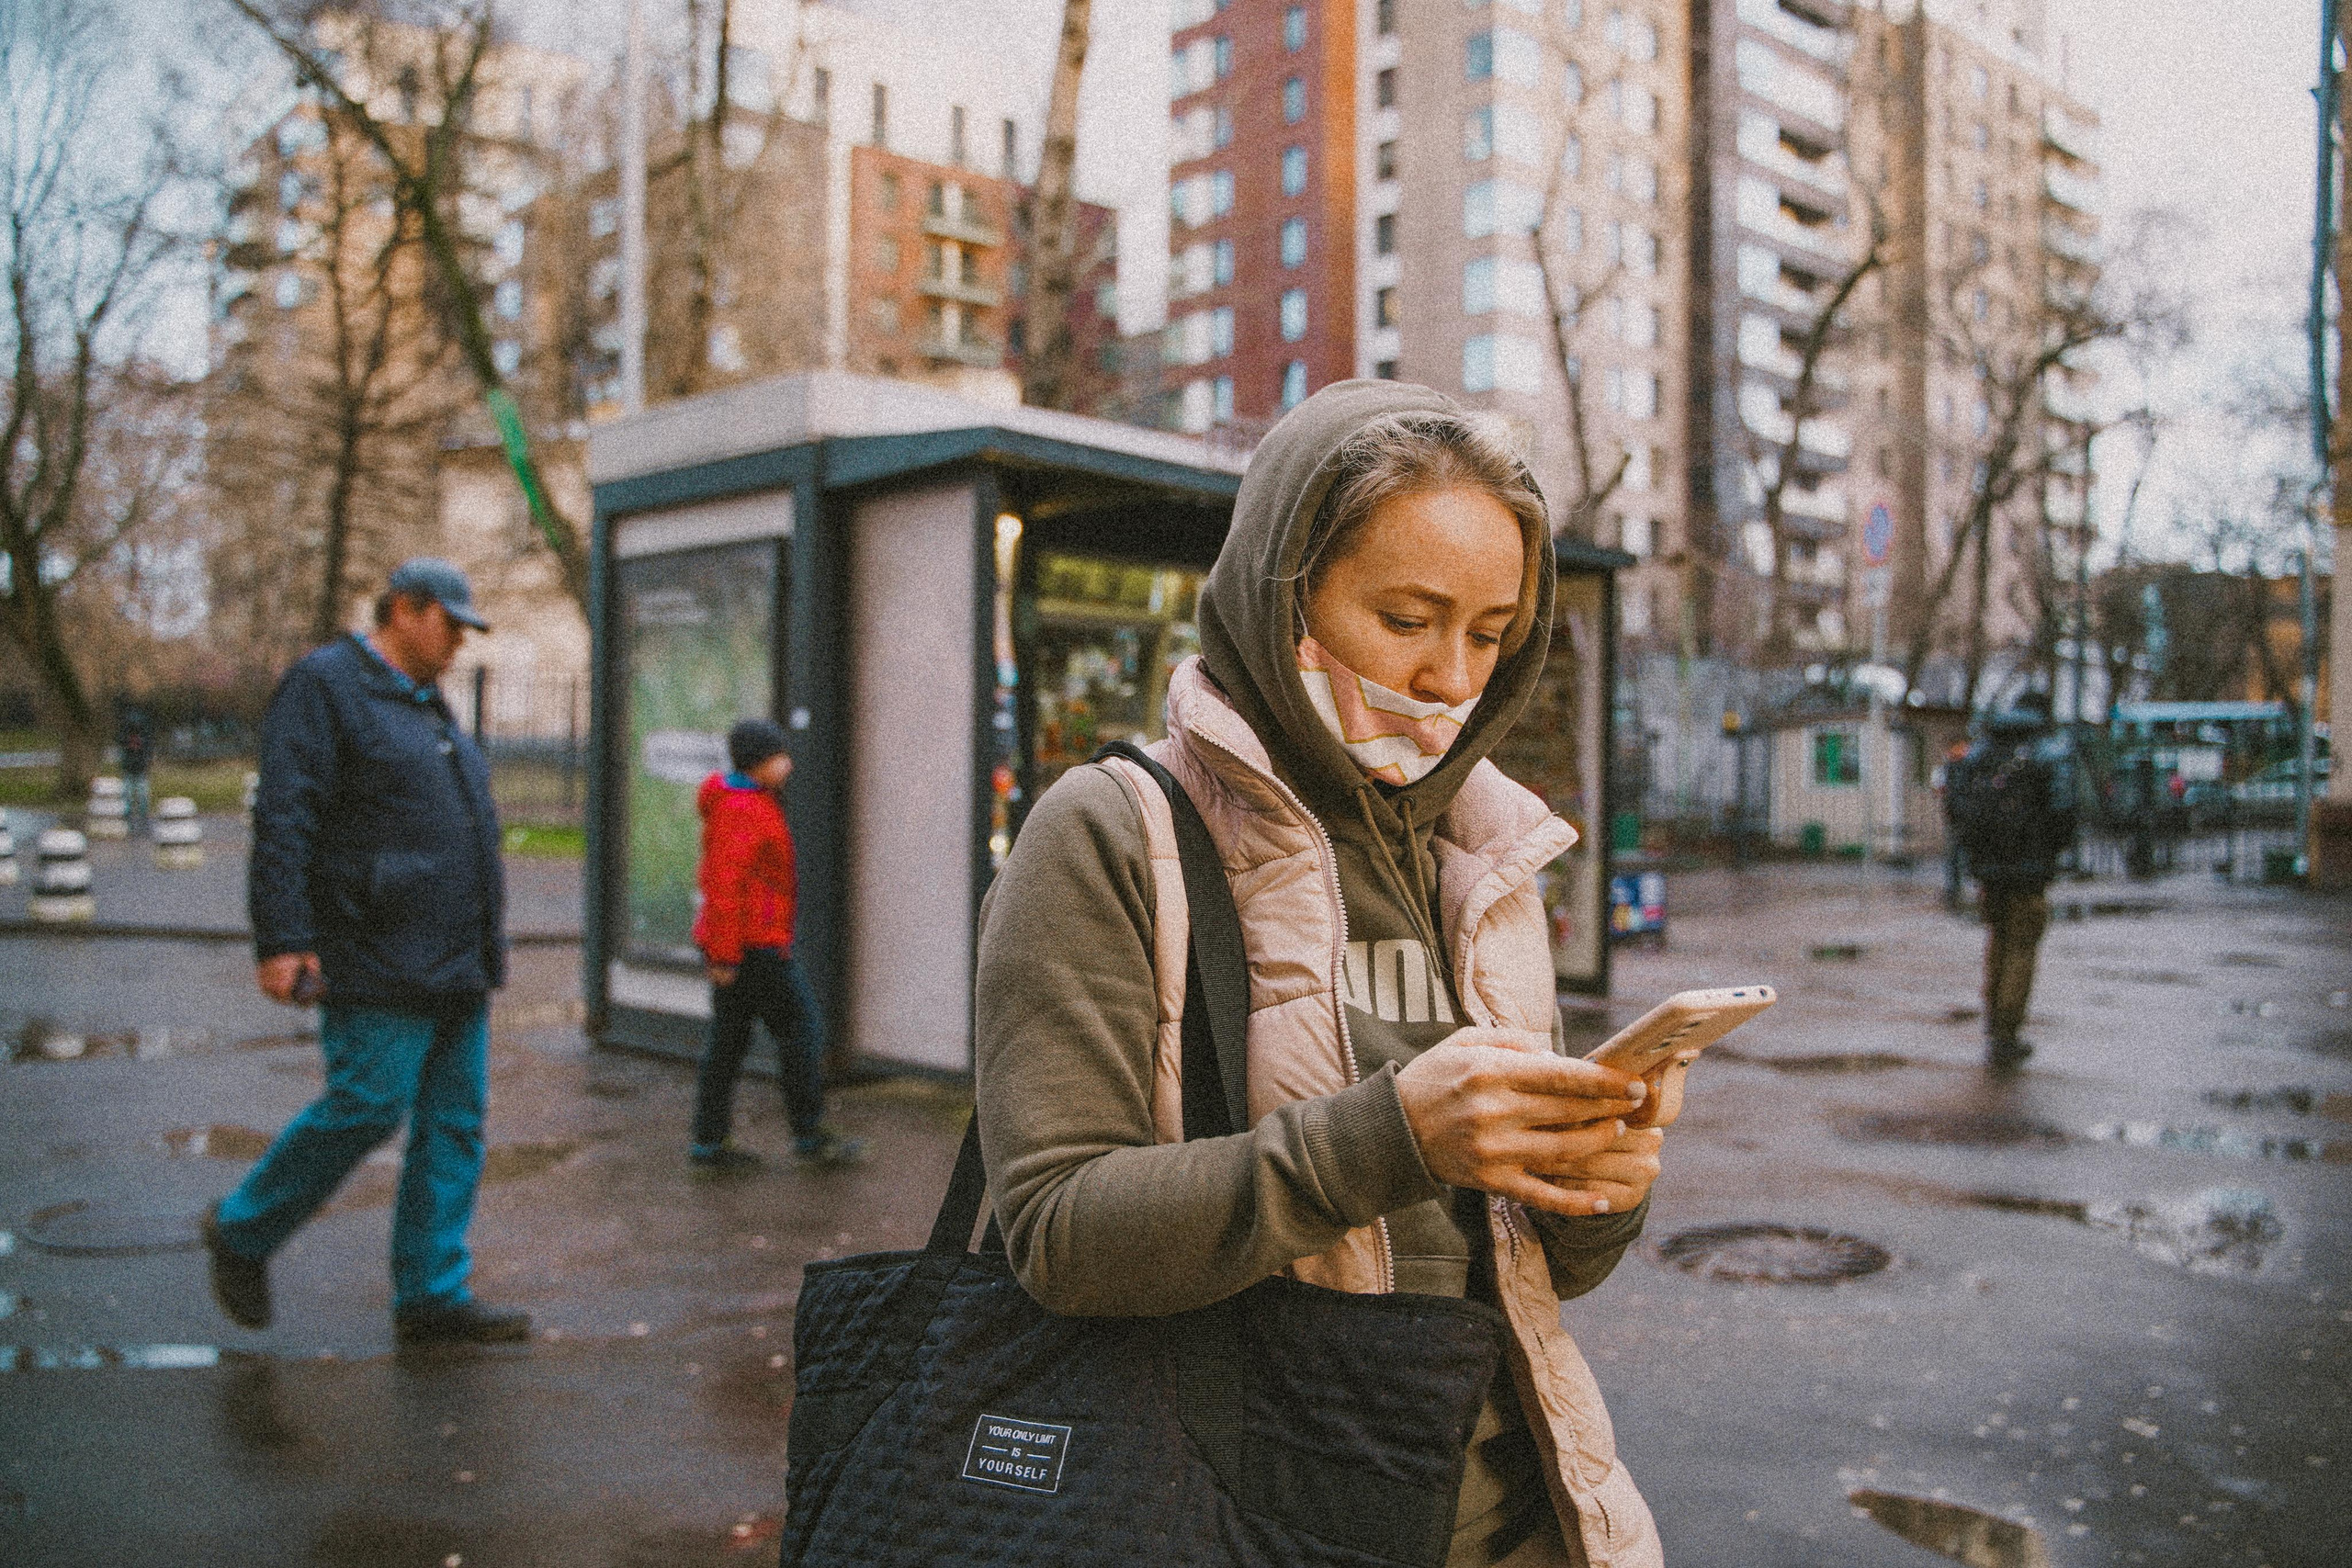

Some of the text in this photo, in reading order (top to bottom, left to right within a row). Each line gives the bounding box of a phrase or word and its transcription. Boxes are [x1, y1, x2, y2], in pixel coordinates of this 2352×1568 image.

[989, 1426, 1056, 1444] YOUR ONLY LIMIT
[1012, 1448, 1021, 1457] IS
[978, 1458, 1047, 1480] YOURSELF
